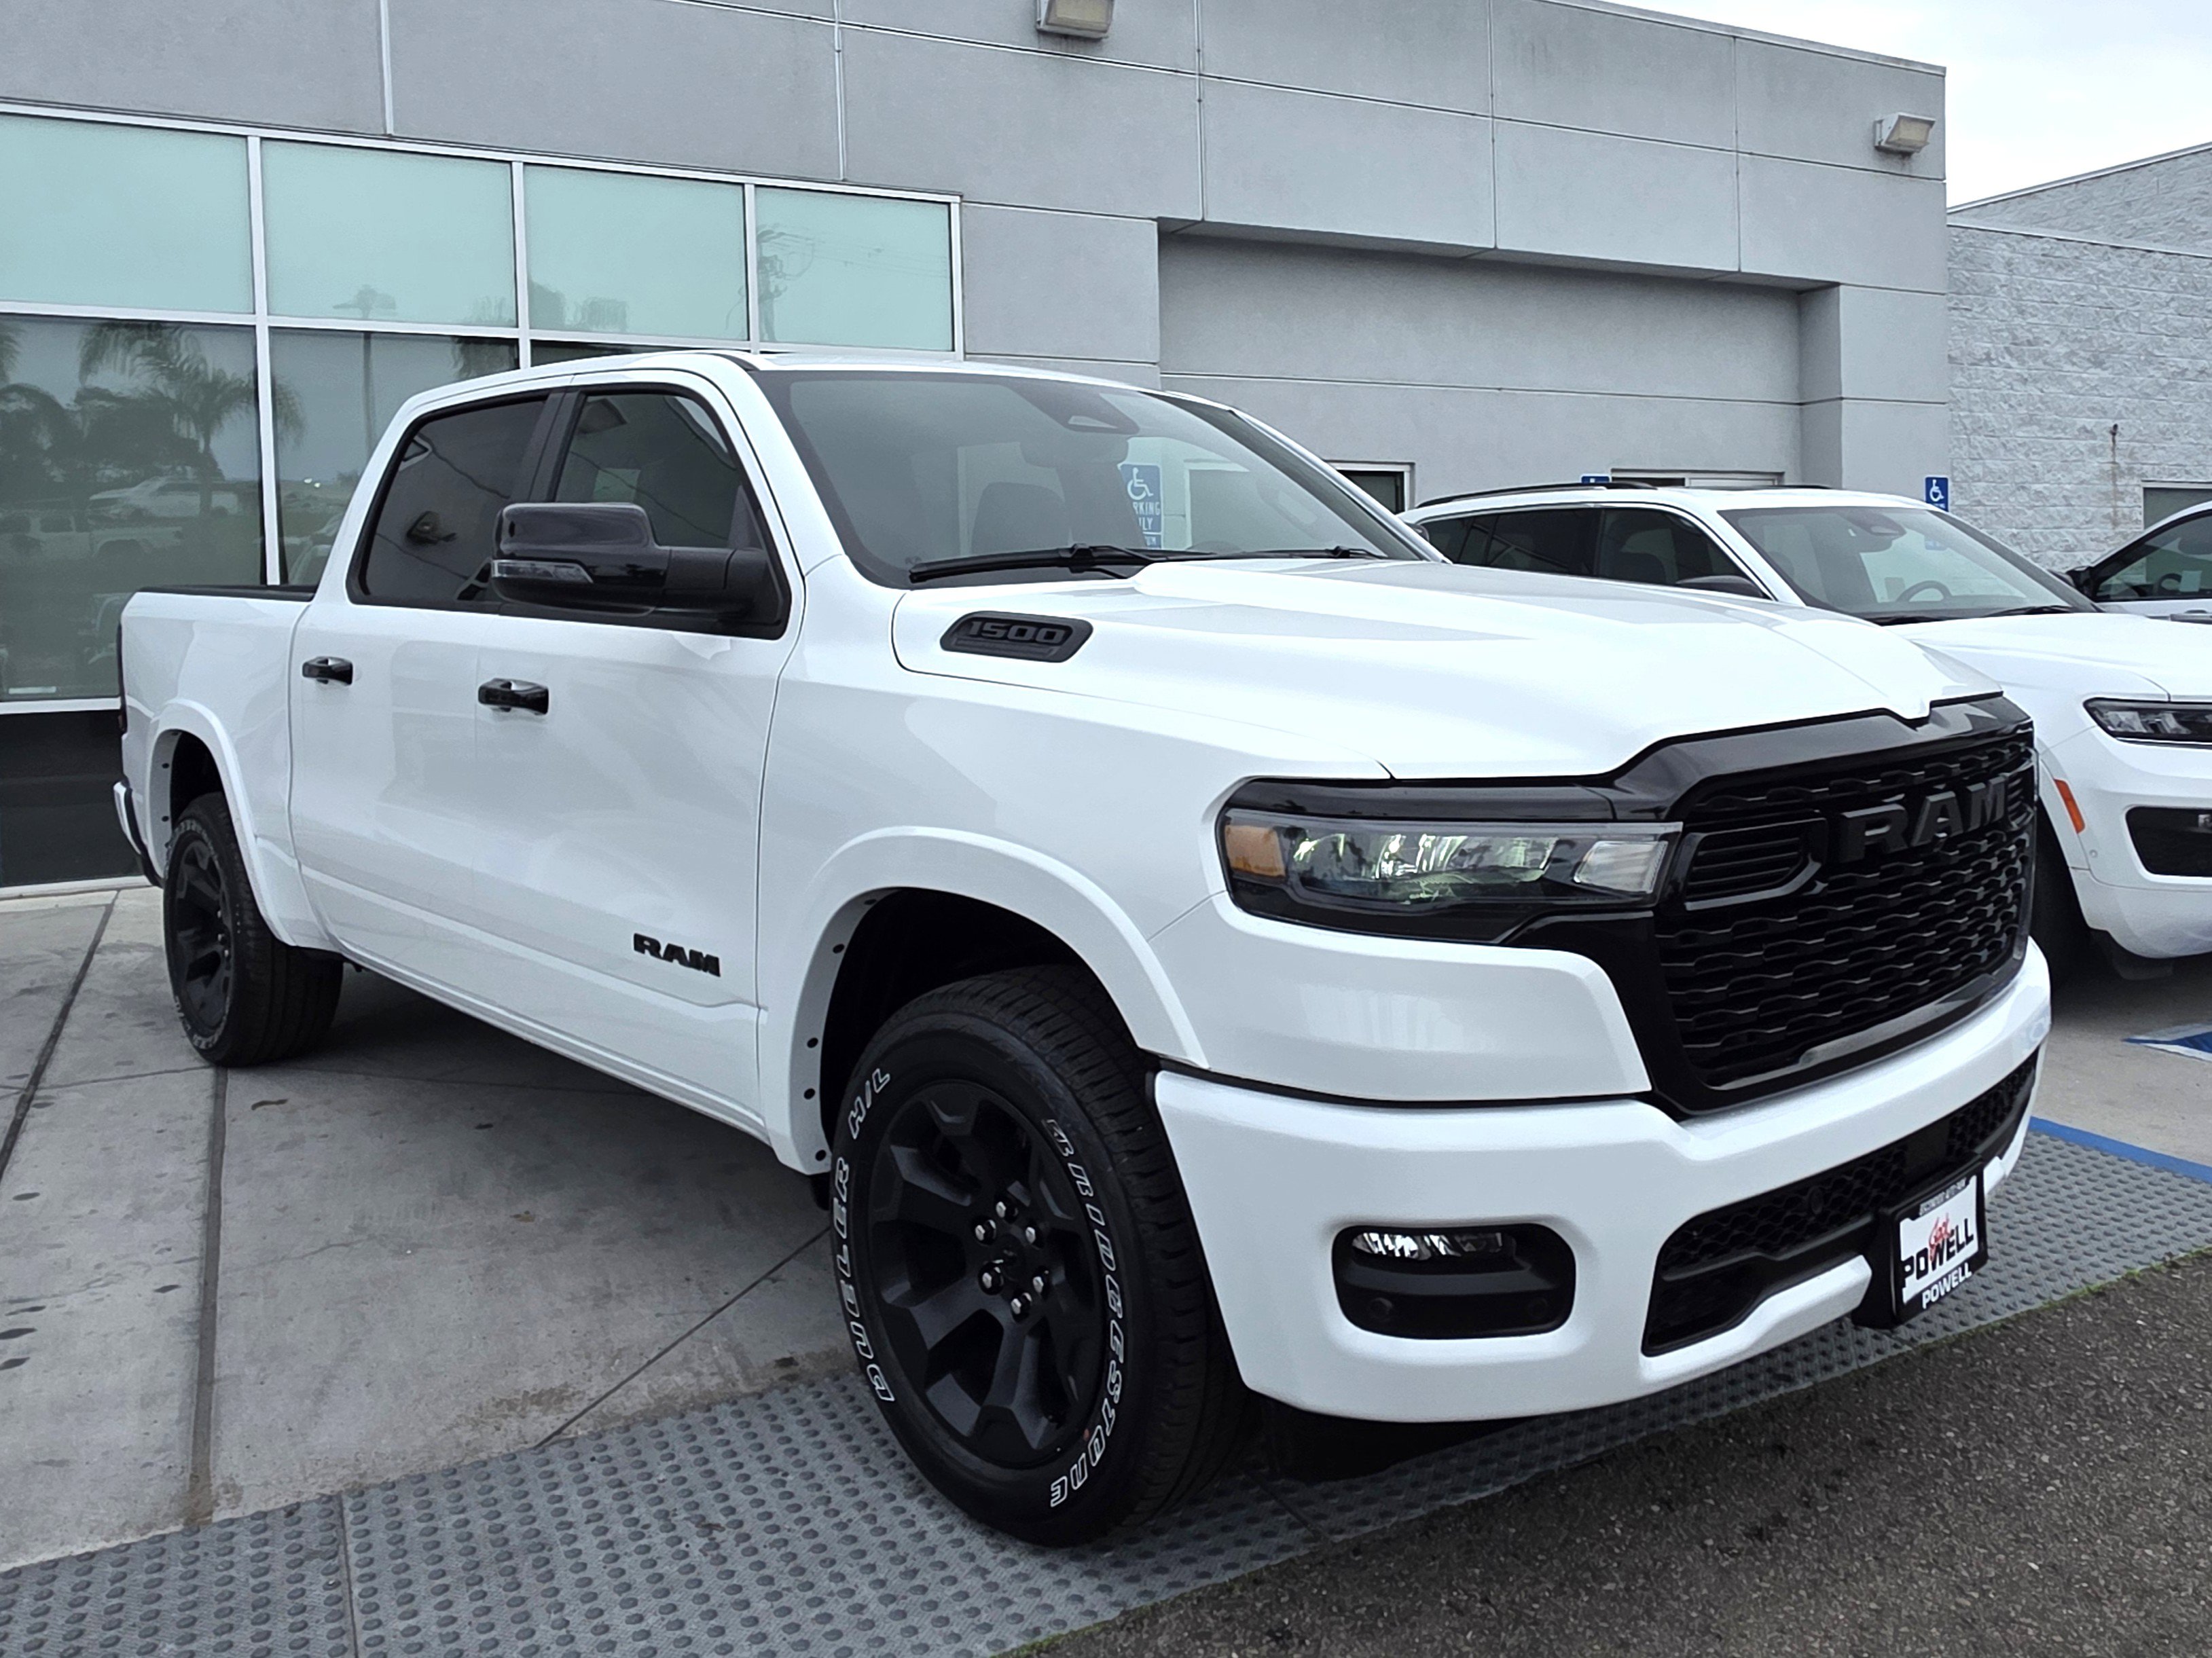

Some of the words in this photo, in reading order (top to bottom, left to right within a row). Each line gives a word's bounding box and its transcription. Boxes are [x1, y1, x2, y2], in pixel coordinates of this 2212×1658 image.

[1132, 501, 1161, 515] RKING
[969, 621, 1066, 644] 1500
[1838, 775, 2007, 864] RAM
[633, 932, 721, 977] RAM
[833, 1156, 896, 1402] DUELER
[1901, 1217, 1974, 1289] POWELL
[1040, 1118, 1125, 1509] BRIDGESTONE
[1921, 1261, 1972, 1309] POWELL
